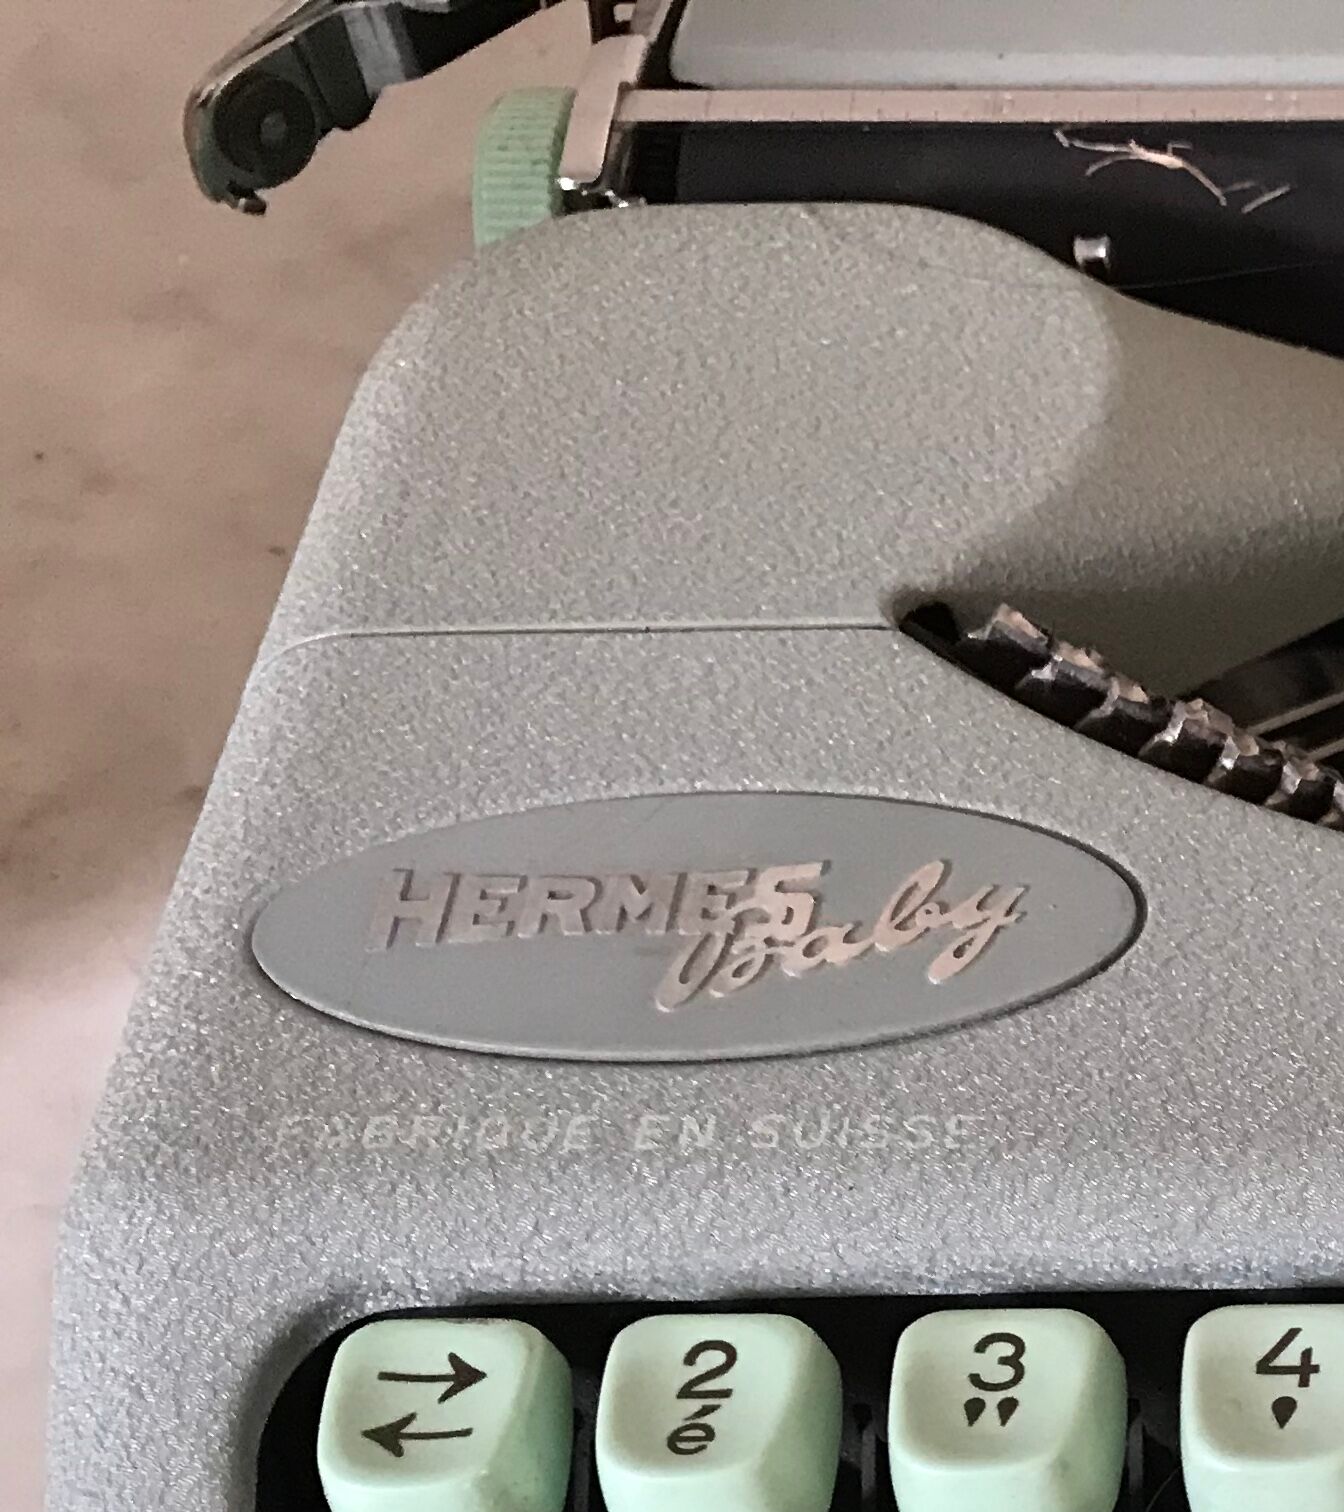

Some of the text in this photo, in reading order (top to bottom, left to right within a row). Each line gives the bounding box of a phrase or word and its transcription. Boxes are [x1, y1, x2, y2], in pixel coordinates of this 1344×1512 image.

[364, 861, 826, 952] HERMES
[635, 1113, 716, 1150] EN
[675, 1339, 738, 1400] 2
[967, 1332, 1026, 1393] 3
[1255, 1327, 1321, 1389] 4
[666, 1404, 722, 1456] é
